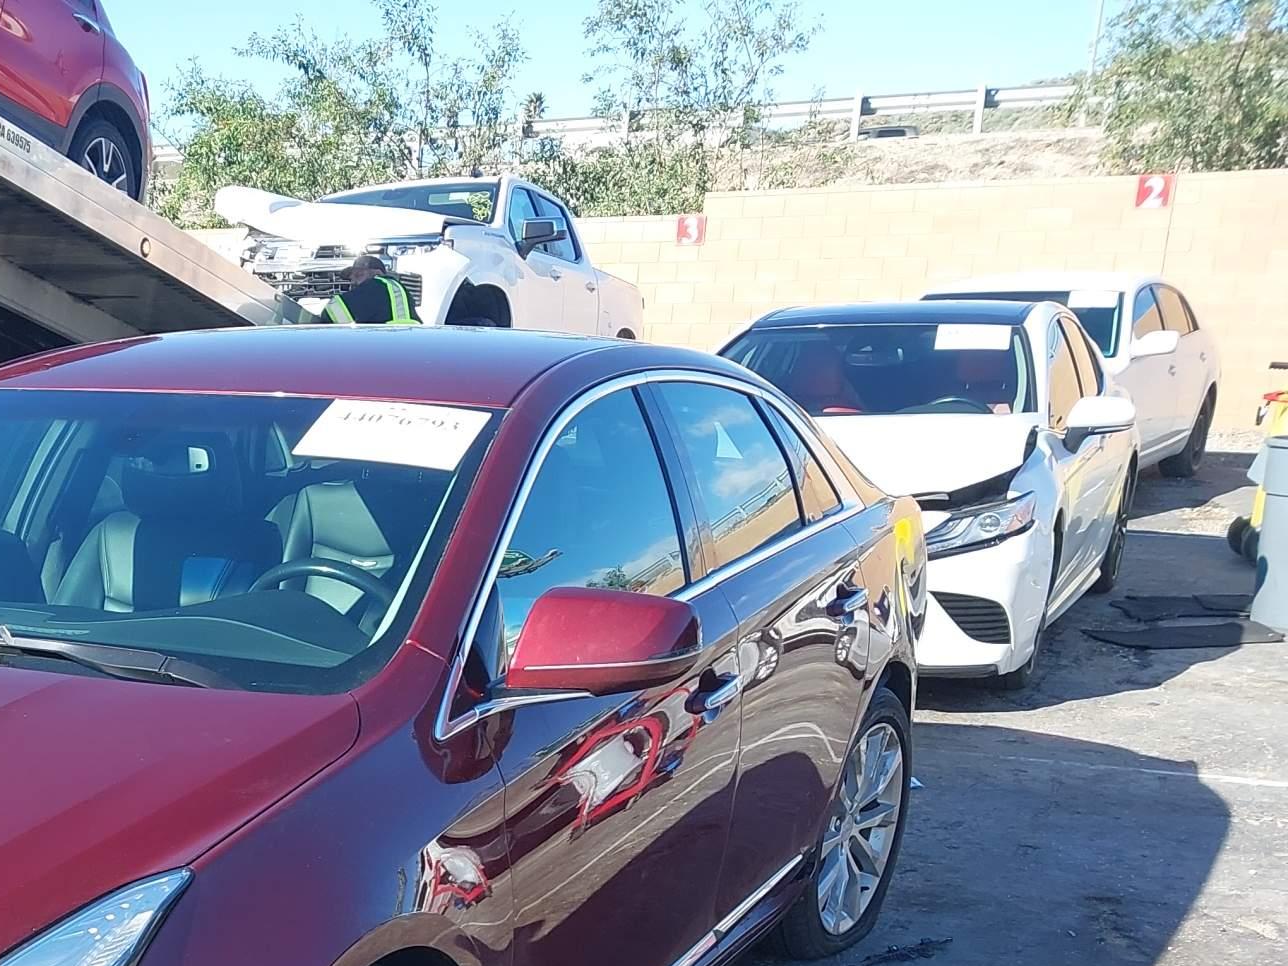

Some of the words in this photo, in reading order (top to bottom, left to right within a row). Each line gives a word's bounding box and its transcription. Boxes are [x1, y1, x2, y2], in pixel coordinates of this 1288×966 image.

[6, 128, 31, 153] 639575
[1142, 175, 1166, 208] 2
[680, 216, 699, 244] 3
